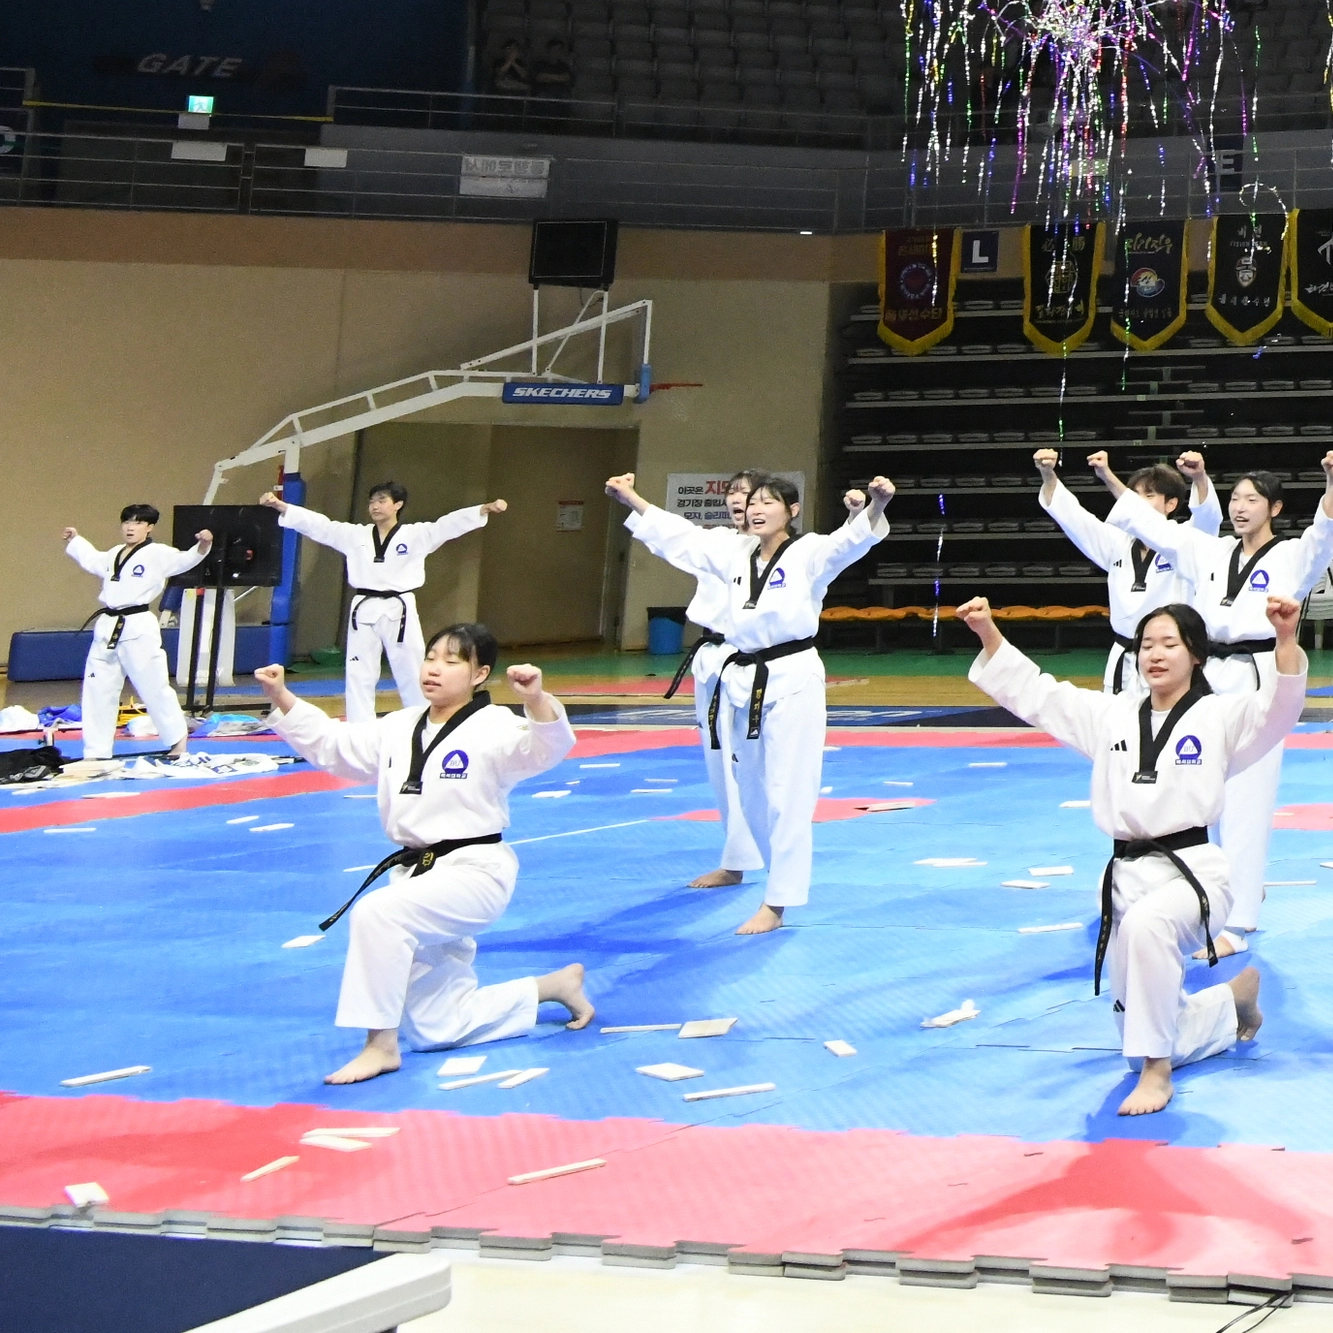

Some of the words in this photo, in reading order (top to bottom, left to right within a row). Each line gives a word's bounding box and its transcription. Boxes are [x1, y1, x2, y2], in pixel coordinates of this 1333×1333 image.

[137, 52, 244, 79] GATE
[971, 239, 990, 264] L
[511, 385, 613, 401] SKECHERS
[677, 486, 704, 495] 이곳은
